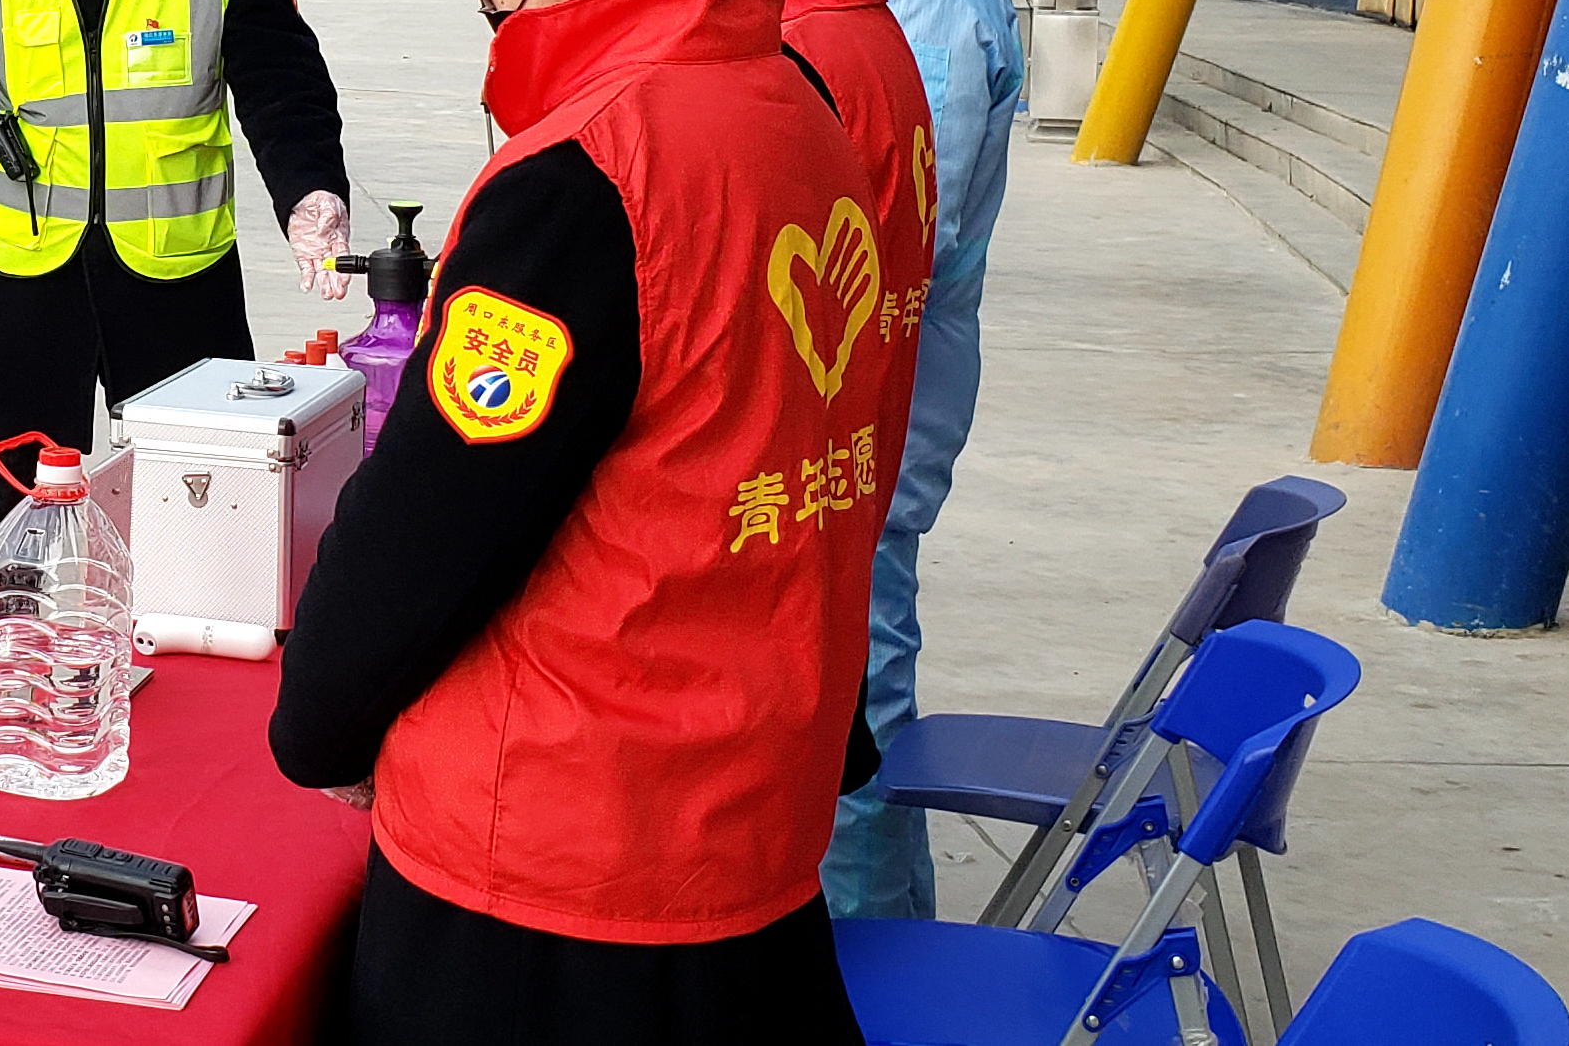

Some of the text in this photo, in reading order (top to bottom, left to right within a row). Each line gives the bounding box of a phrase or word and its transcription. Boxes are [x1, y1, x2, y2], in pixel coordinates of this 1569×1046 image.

[463, 302, 557, 350] 周口东服务区
[462, 327, 541, 378] 安全员
